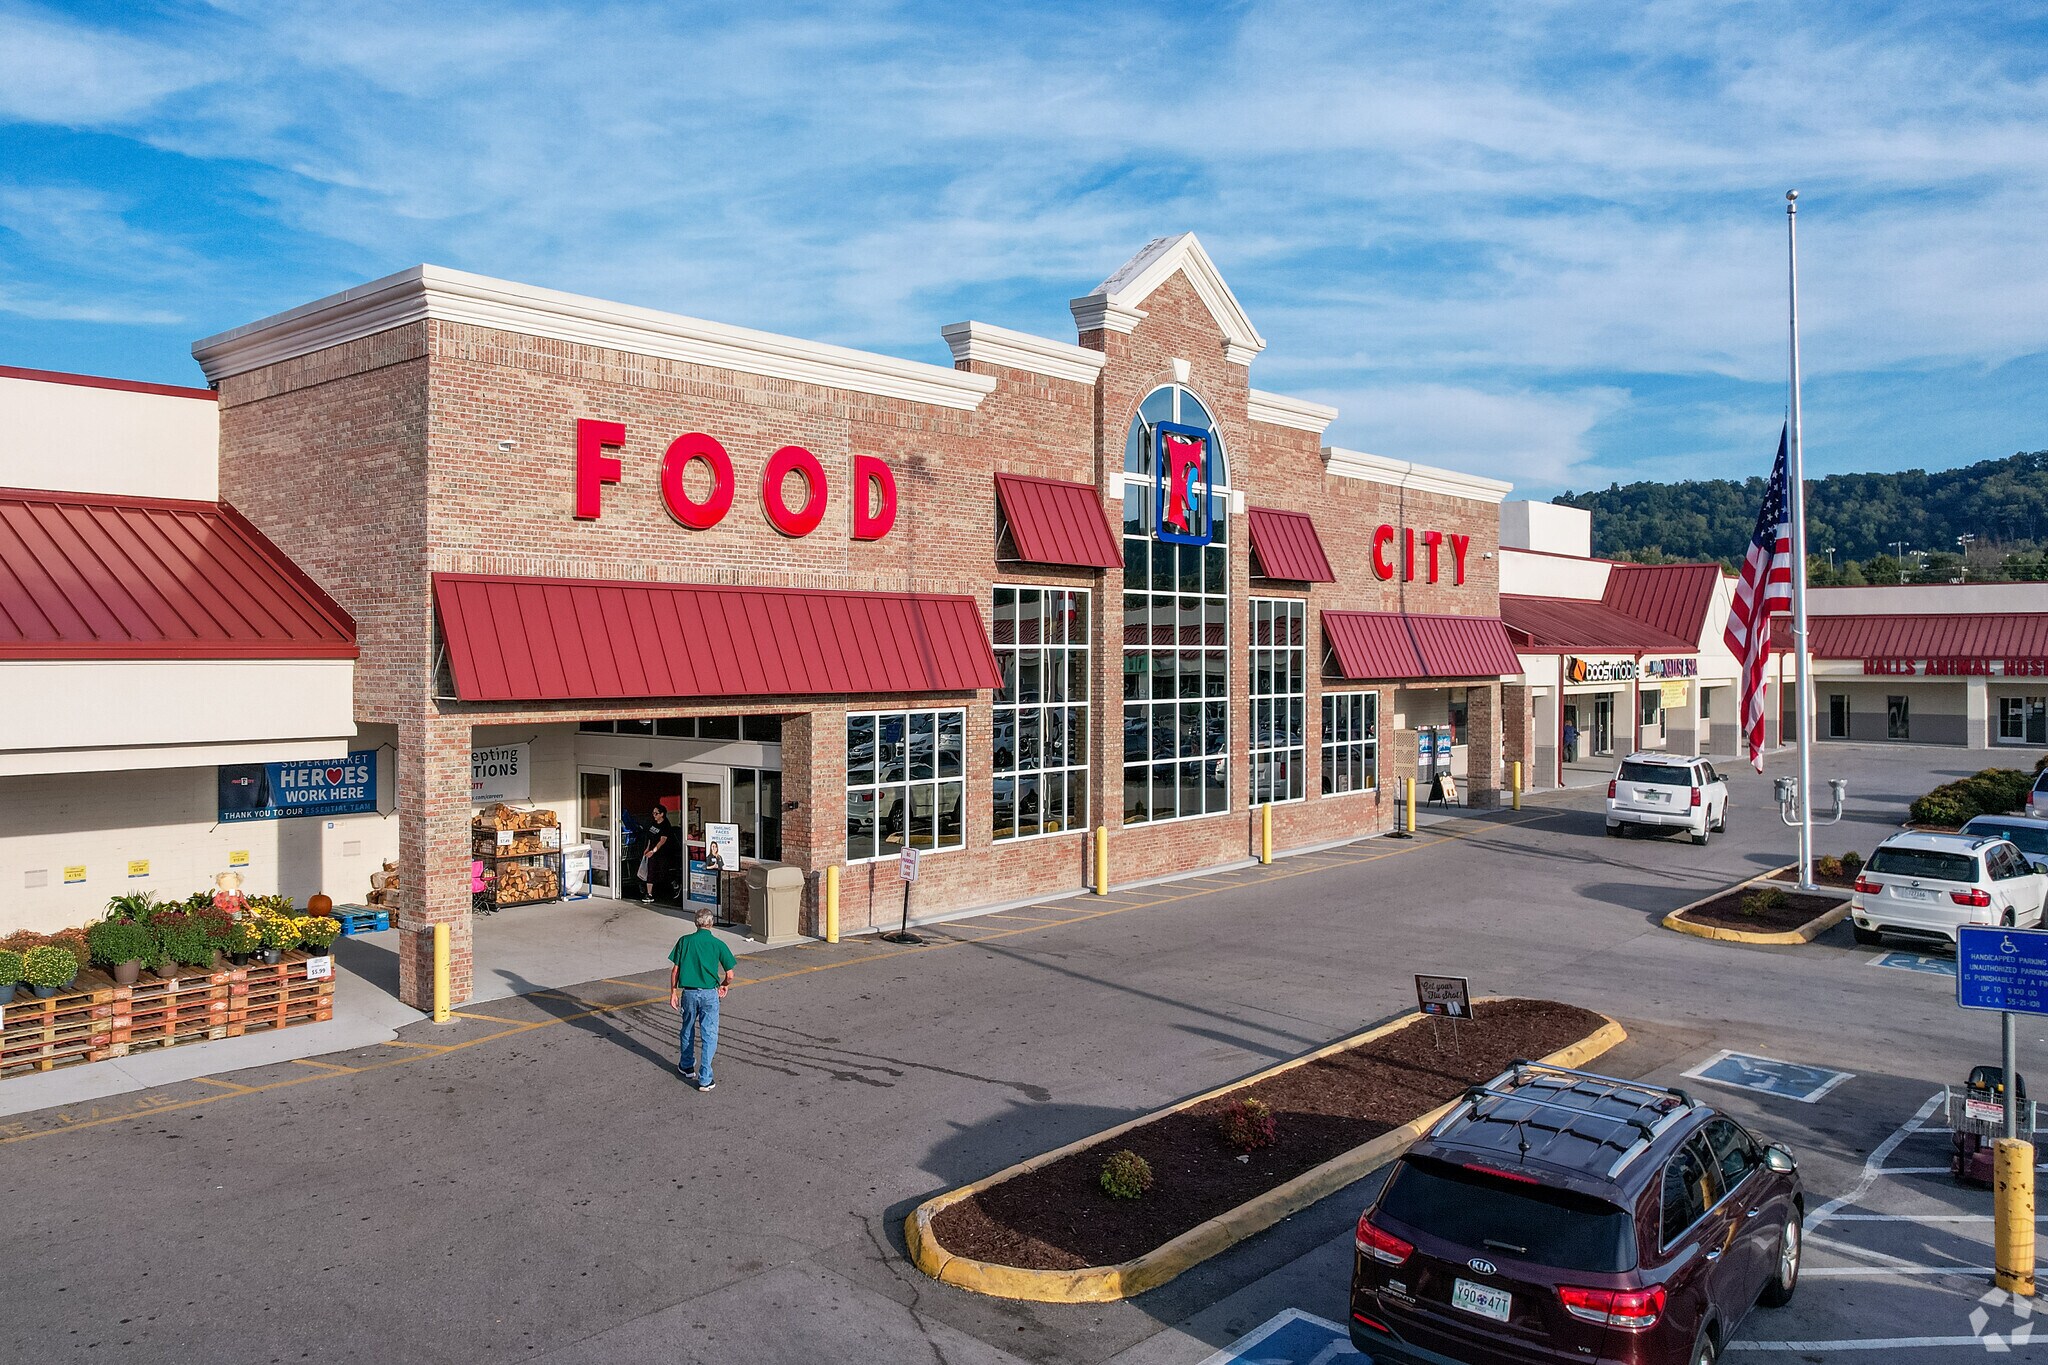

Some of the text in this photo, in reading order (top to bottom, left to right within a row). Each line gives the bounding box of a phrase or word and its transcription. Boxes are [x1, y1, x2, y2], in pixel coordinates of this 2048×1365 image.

[575, 418, 897, 539] FOOD
[1370, 524, 1469, 586] CITY
[1864, 658, 1916, 675] HALLS
[1925, 658, 1995, 676] ANIMAL
[281, 754, 368, 768] SUPERMARKET
[286, 786, 364, 803] WORK HERE
[224, 811, 252, 820] THANK
[254, 809, 271, 818] YOU
[286, 808, 304, 816] OUR
[305, 805, 348, 814] ESSENTIAL
[350, 803, 371, 811] TEAM
[1970, 953, 2047, 966] HANDICAPPED PARKING
[1969, 964, 2018, 974] UNAUTHORIZED
[1974, 974, 2014, 984] PUNISHABLE
[1421, 981, 1453, 992] Get your
[1427, 990, 1463, 1000] Flu Shot!
[1471, 1260, 1491, 1273] KIA
